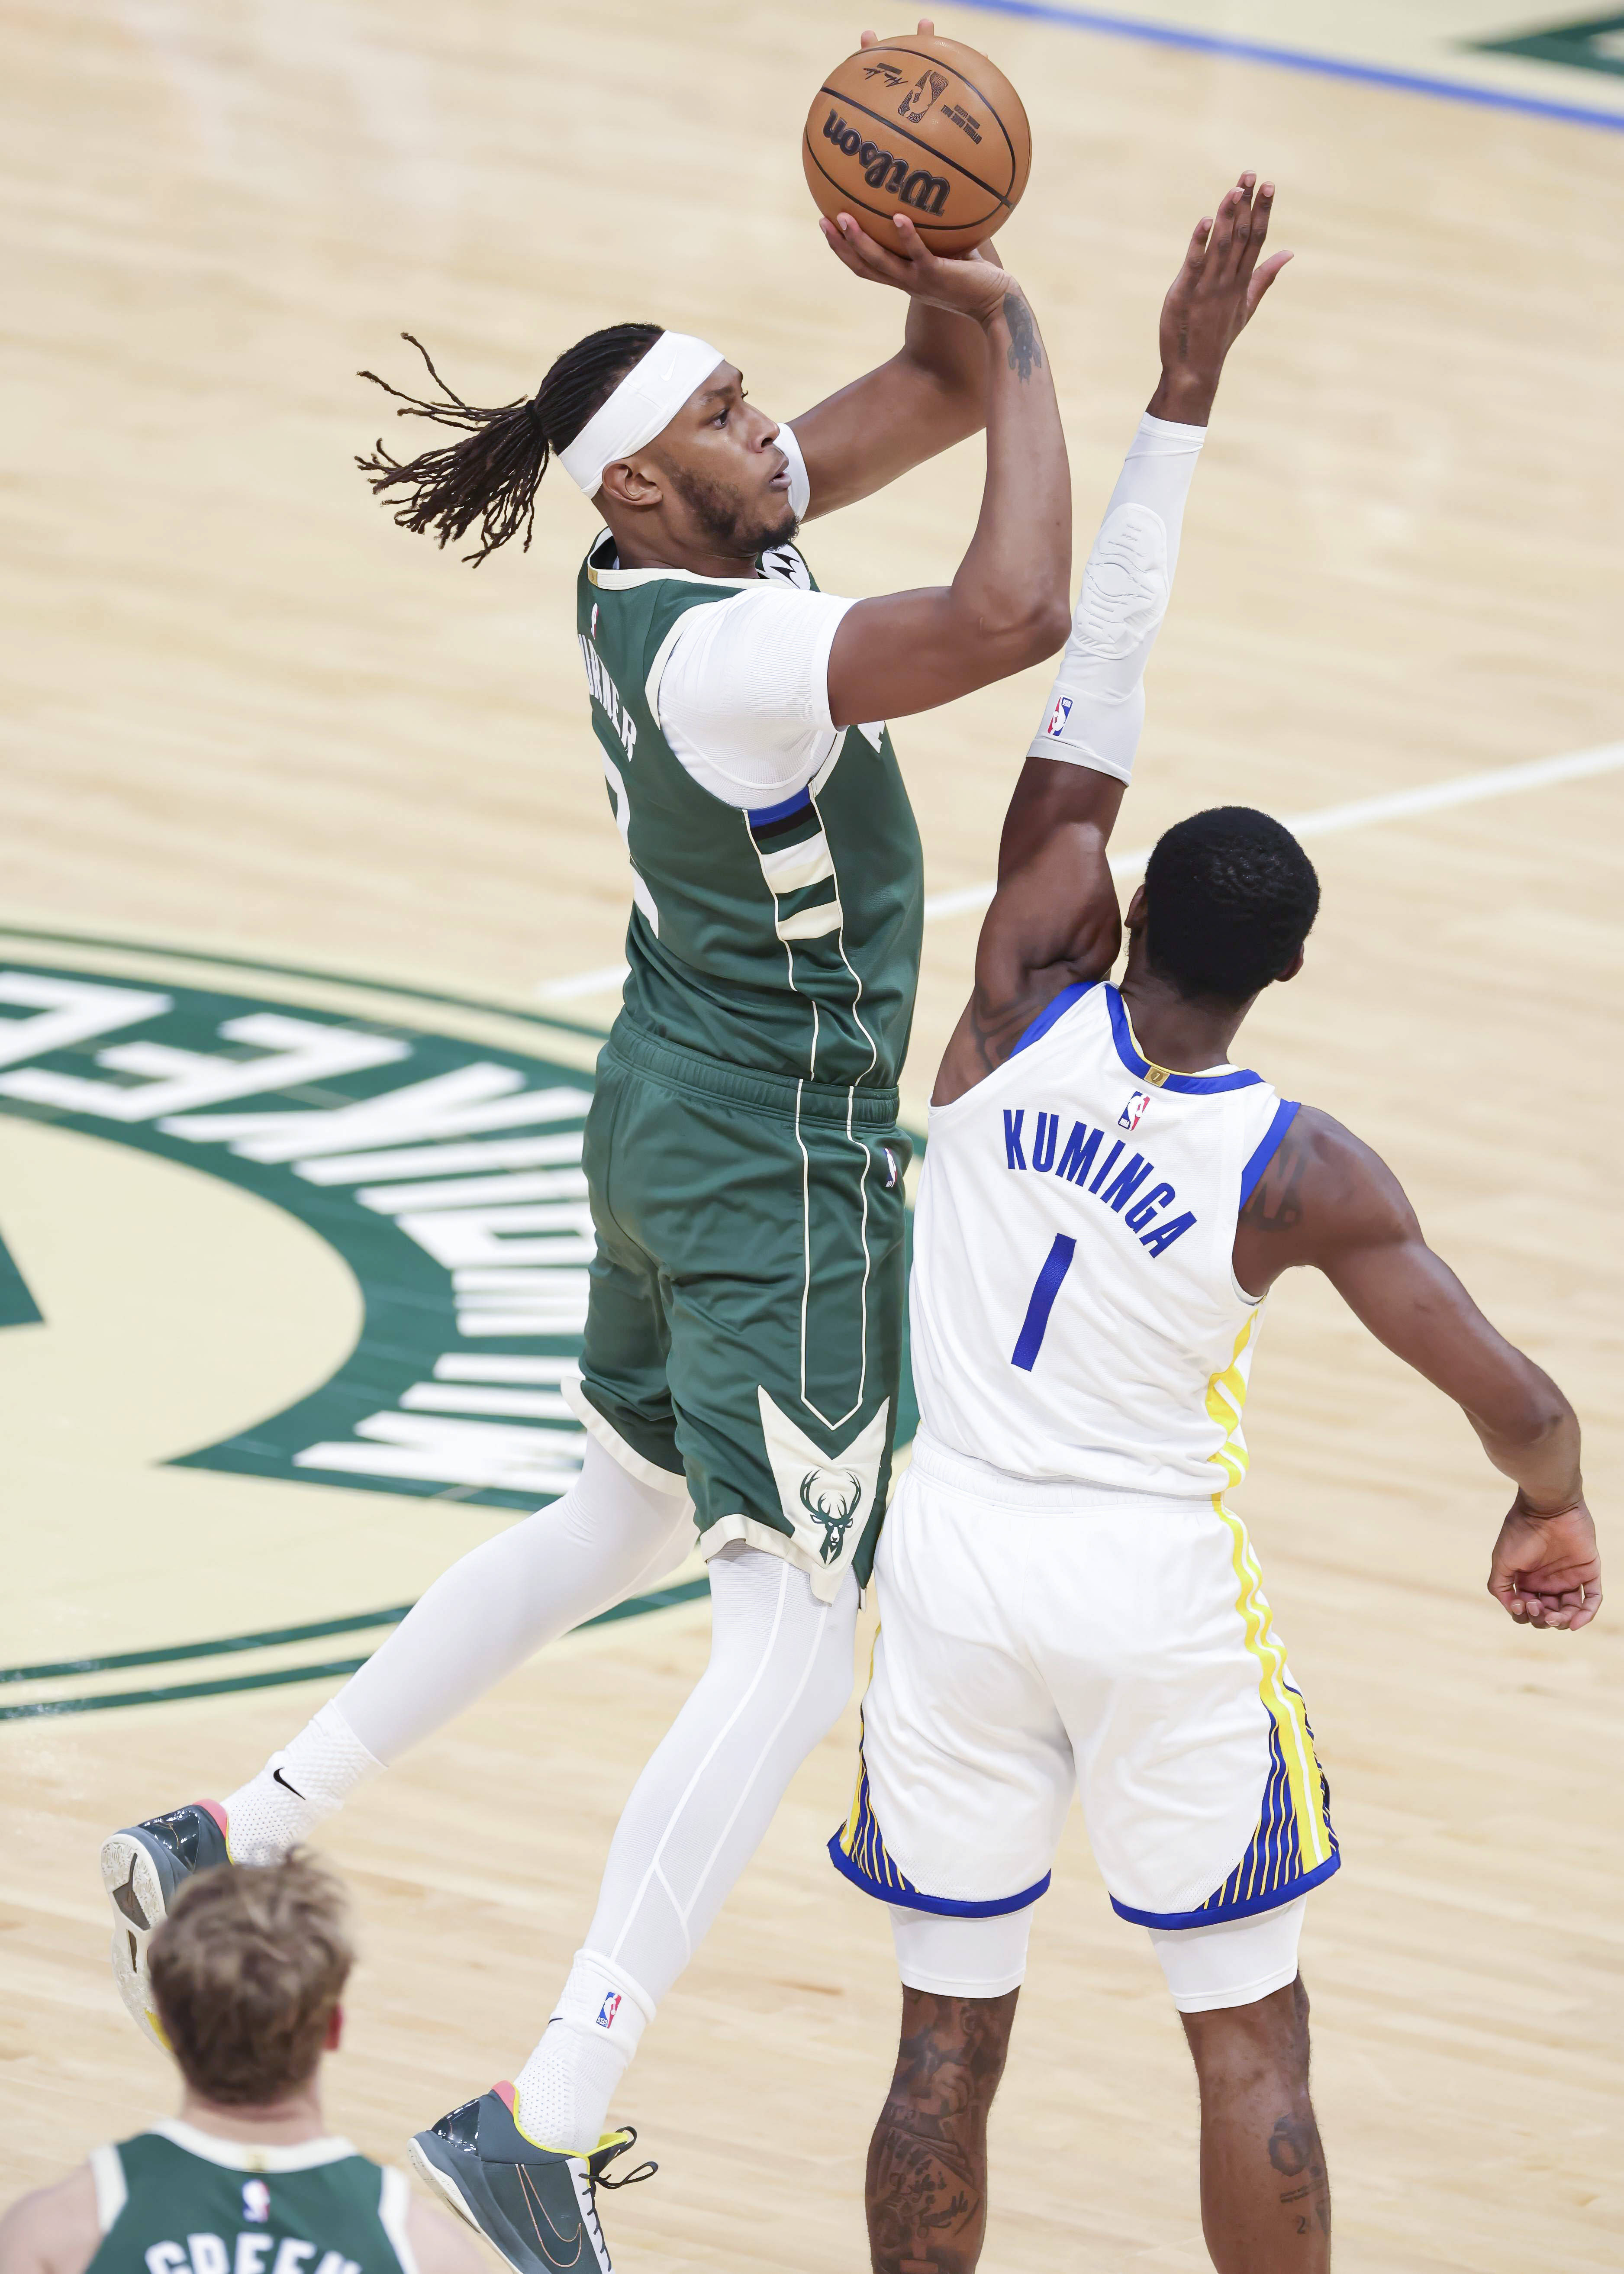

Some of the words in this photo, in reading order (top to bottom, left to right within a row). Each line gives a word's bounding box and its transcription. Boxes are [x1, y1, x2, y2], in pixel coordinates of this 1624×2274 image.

[822, 108, 951, 216] Wilson
[1003, 1109, 1197, 1258] KUMINGA
[1011, 1233, 1077, 1372] 1
